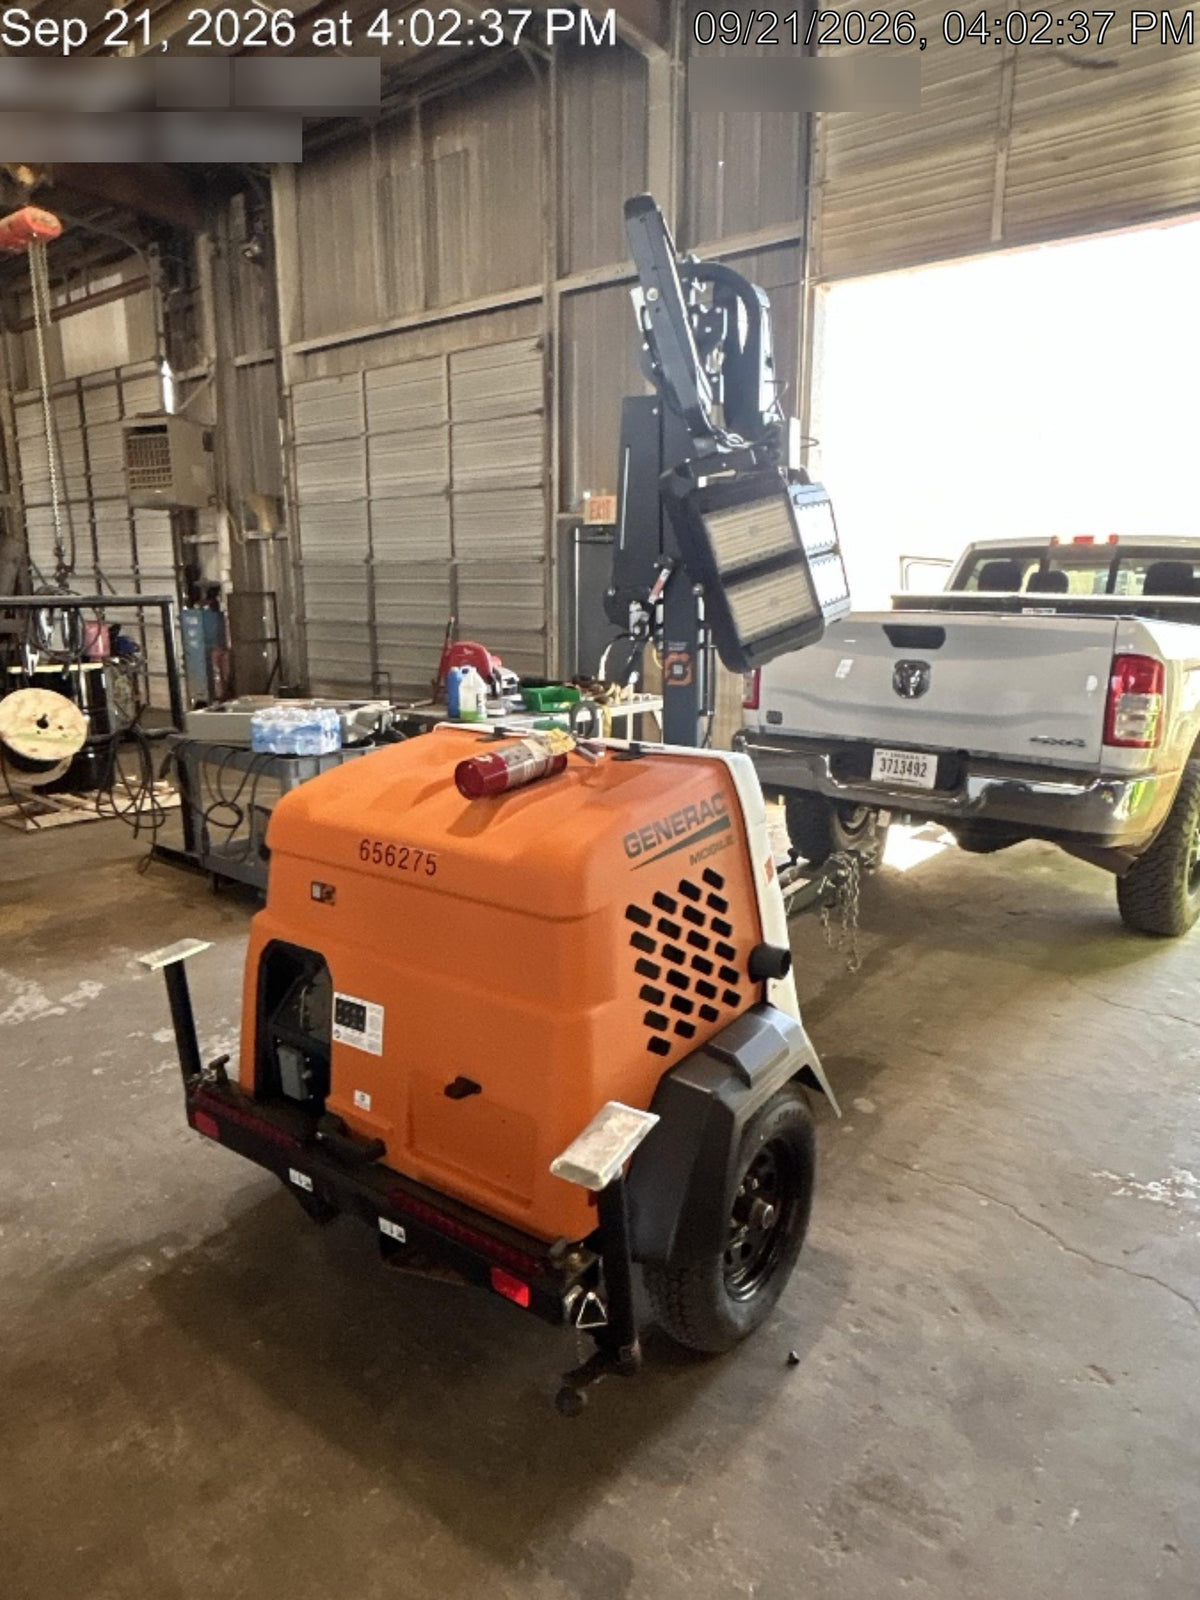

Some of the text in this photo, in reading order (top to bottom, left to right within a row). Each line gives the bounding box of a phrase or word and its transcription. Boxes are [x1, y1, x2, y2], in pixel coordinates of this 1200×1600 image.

[589, 499, 612, 519] EXIT
[879, 757, 927, 778] 3713492
[623, 792, 728, 859] GENERAC
[359, 838, 437, 876] 656275
